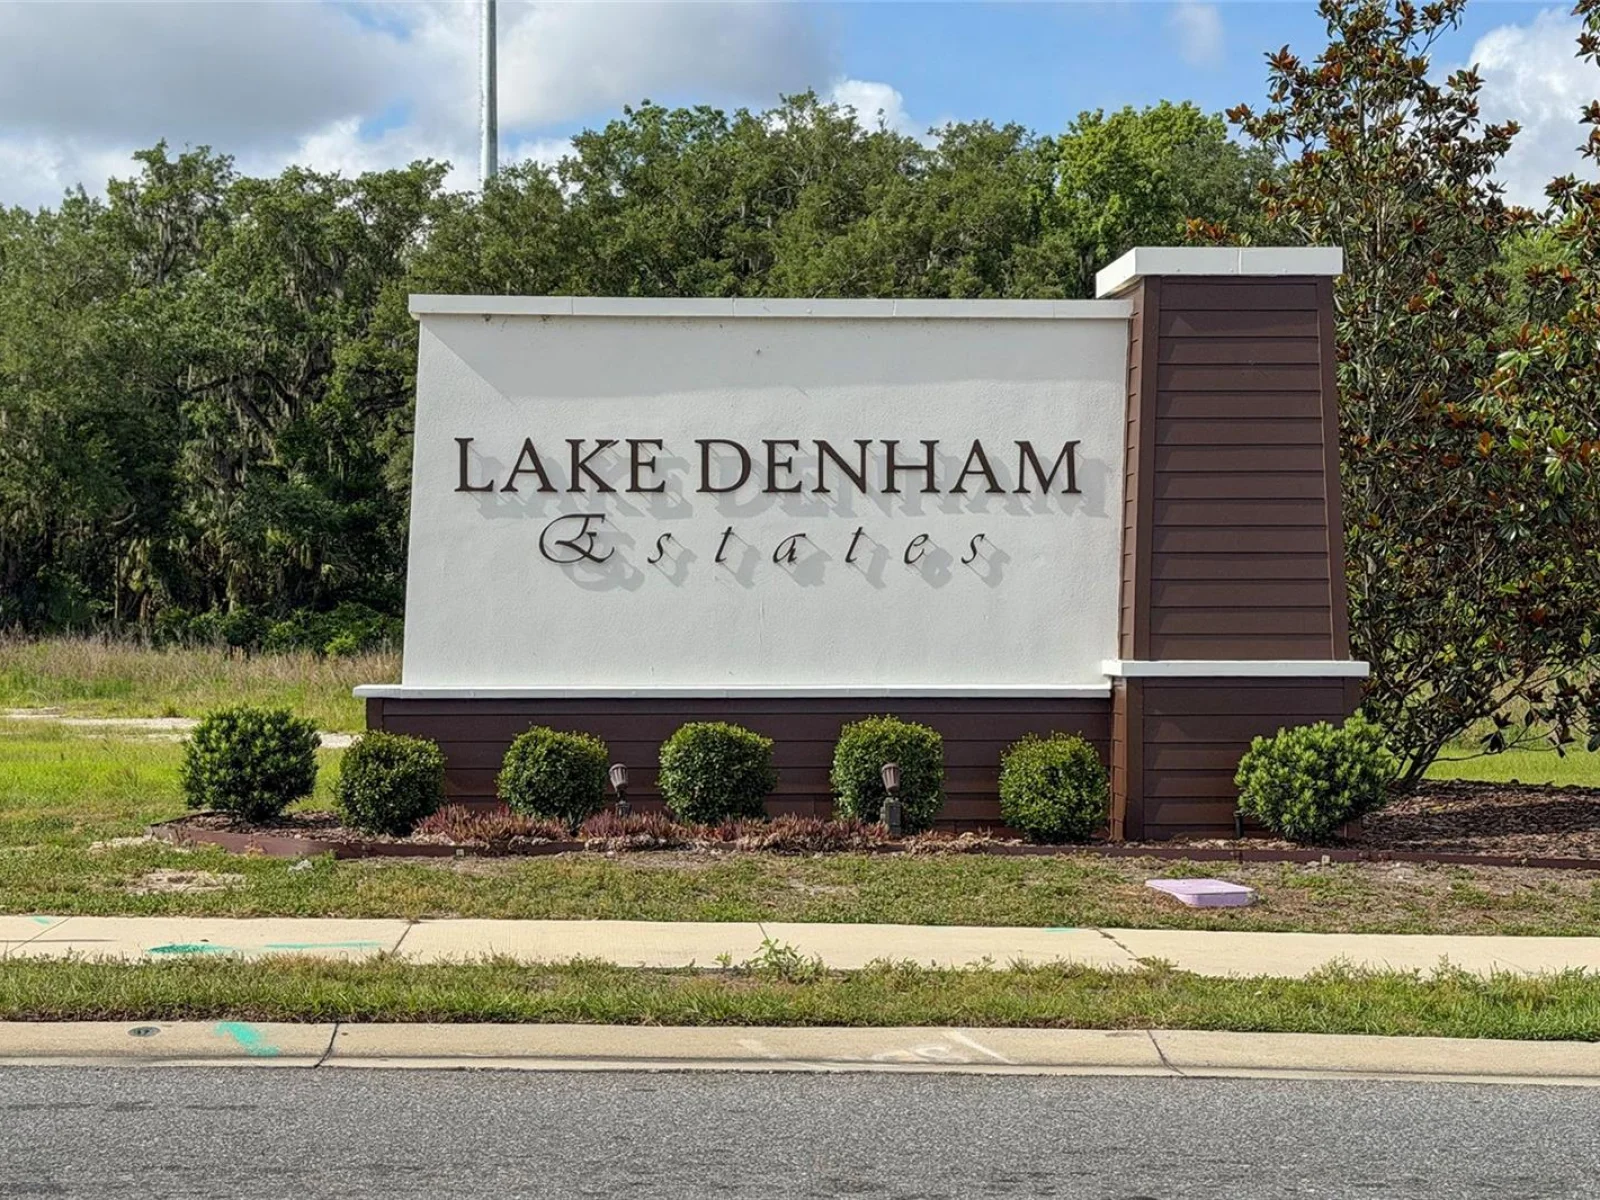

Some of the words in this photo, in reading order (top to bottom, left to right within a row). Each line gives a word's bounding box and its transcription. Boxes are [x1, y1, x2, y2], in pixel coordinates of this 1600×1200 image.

[454, 437, 667, 494] LAKE
[694, 439, 1082, 495] DENHAM
[538, 513, 987, 565] Estates
